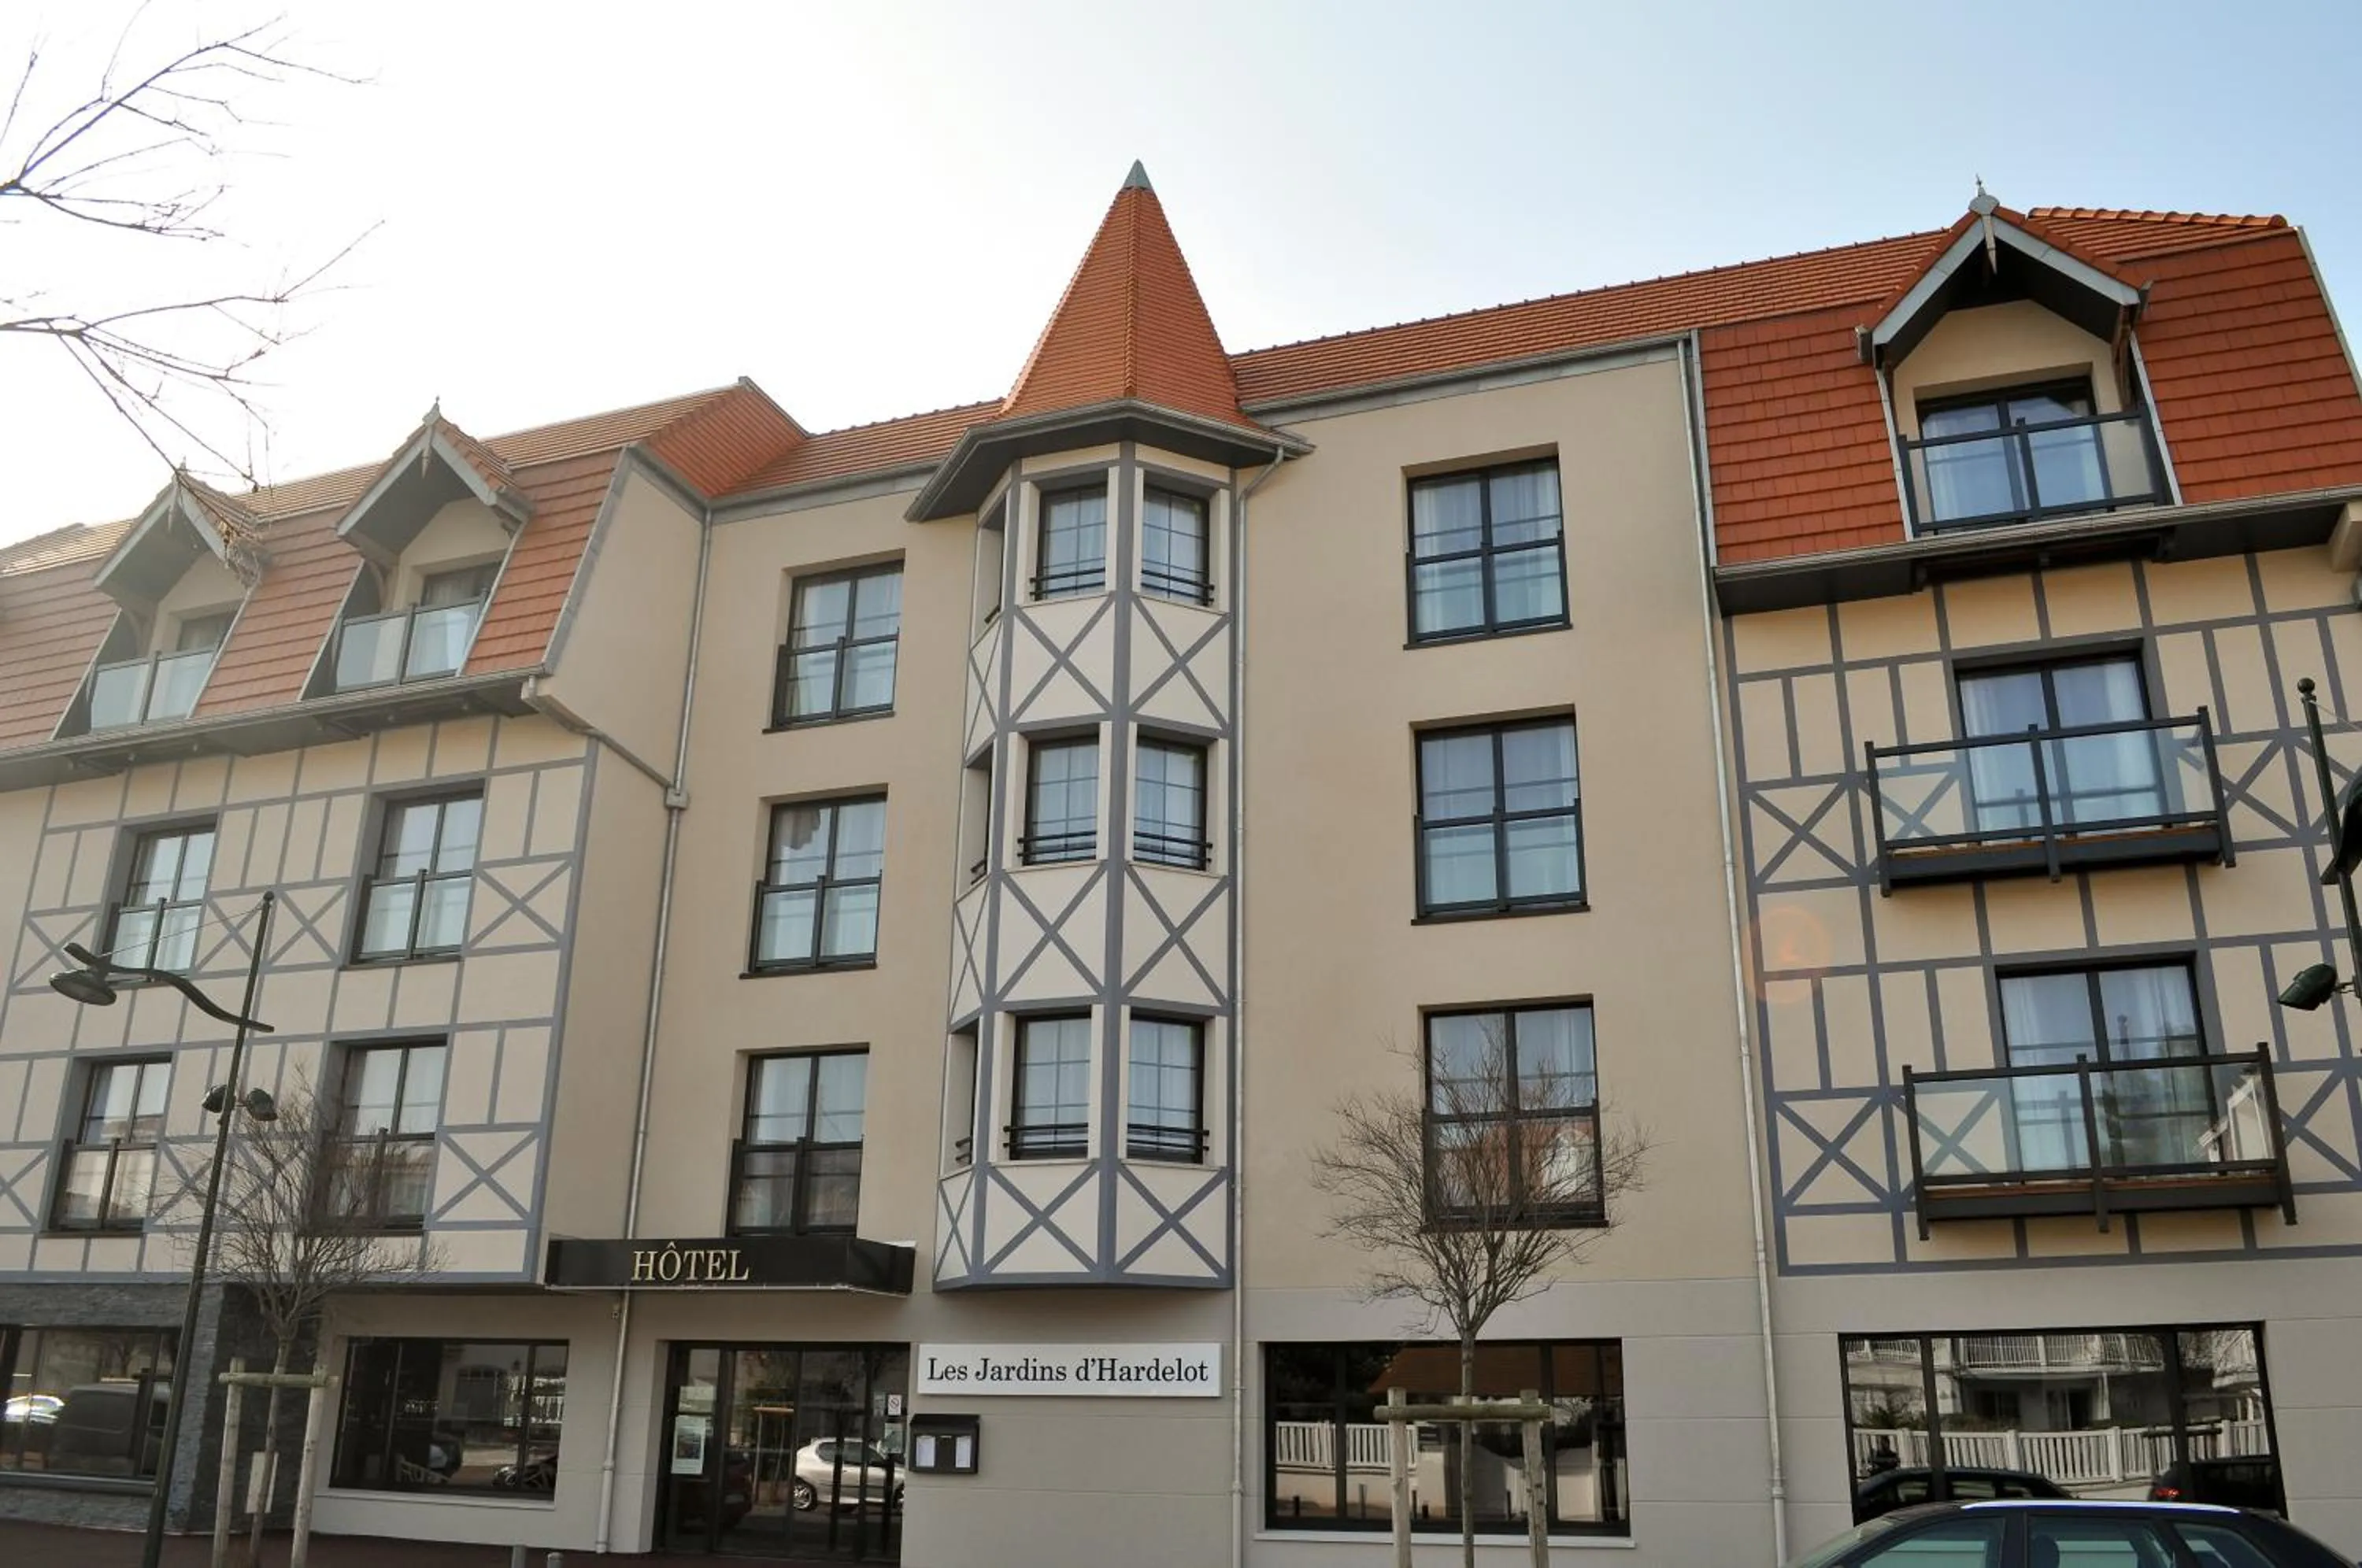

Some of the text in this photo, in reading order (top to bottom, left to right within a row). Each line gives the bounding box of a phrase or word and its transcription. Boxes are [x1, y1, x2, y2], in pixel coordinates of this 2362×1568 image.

[631, 1241, 749, 1281] HÔTEL
[927, 1358, 1209, 1381] Les Jardins d'Hardelot
